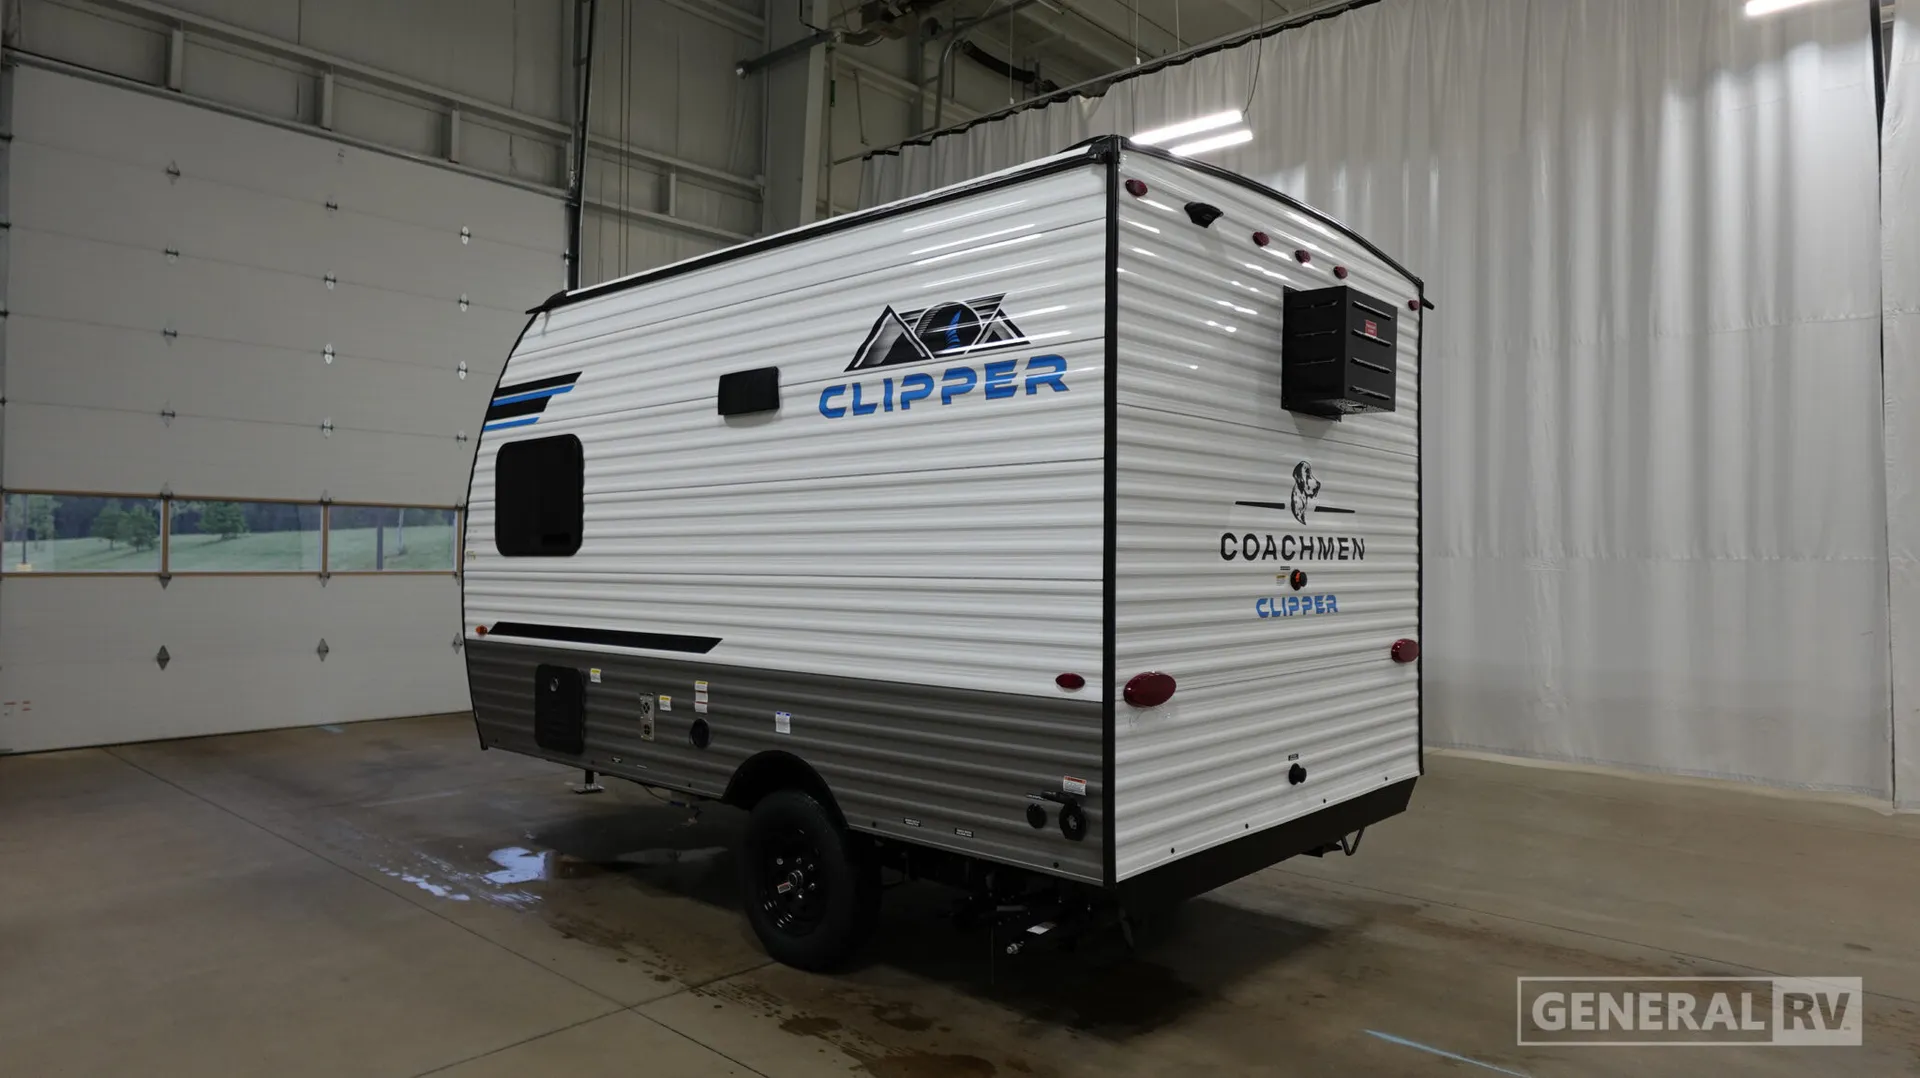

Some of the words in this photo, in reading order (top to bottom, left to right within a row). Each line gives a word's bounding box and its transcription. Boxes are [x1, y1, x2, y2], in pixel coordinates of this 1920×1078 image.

[818, 353, 1071, 419] CLIPPER
[1220, 532, 1365, 561] COACHMEN
[1255, 594, 1339, 618] CLIPPER
